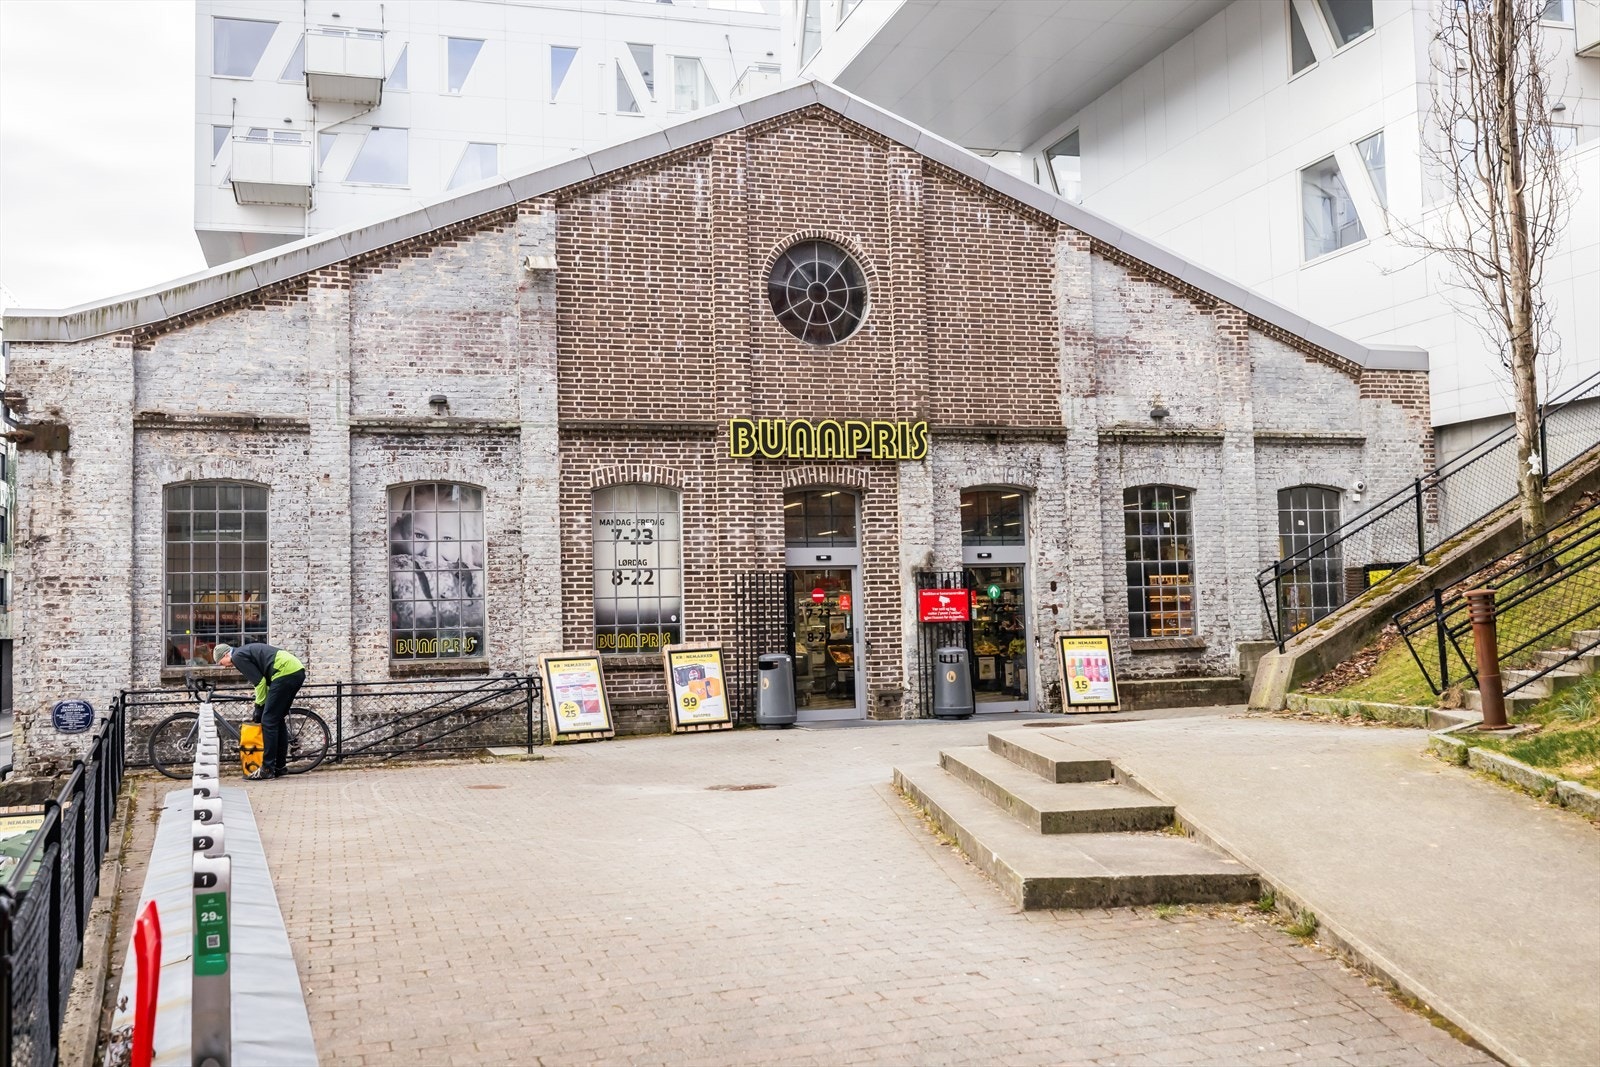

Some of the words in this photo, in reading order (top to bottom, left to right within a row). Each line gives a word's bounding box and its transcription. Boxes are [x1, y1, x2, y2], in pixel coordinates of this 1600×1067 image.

[730, 418, 928, 460] BUNNPRIS
[611, 528, 653, 545] 7-23
[618, 559, 648, 567] LØRDAG
[611, 569, 655, 586] 8-22
[395, 637, 475, 654] BUNNPRIS
[596, 632, 671, 649] BUNNPRIS
[1075, 680, 1088, 690] 15
[683, 697, 697, 707] 99
[565, 710, 577, 718] 25
[199, 811, 206, 820] 3
[198, 839, 206, 848] 2
[201, 875, 208, 886] 1
